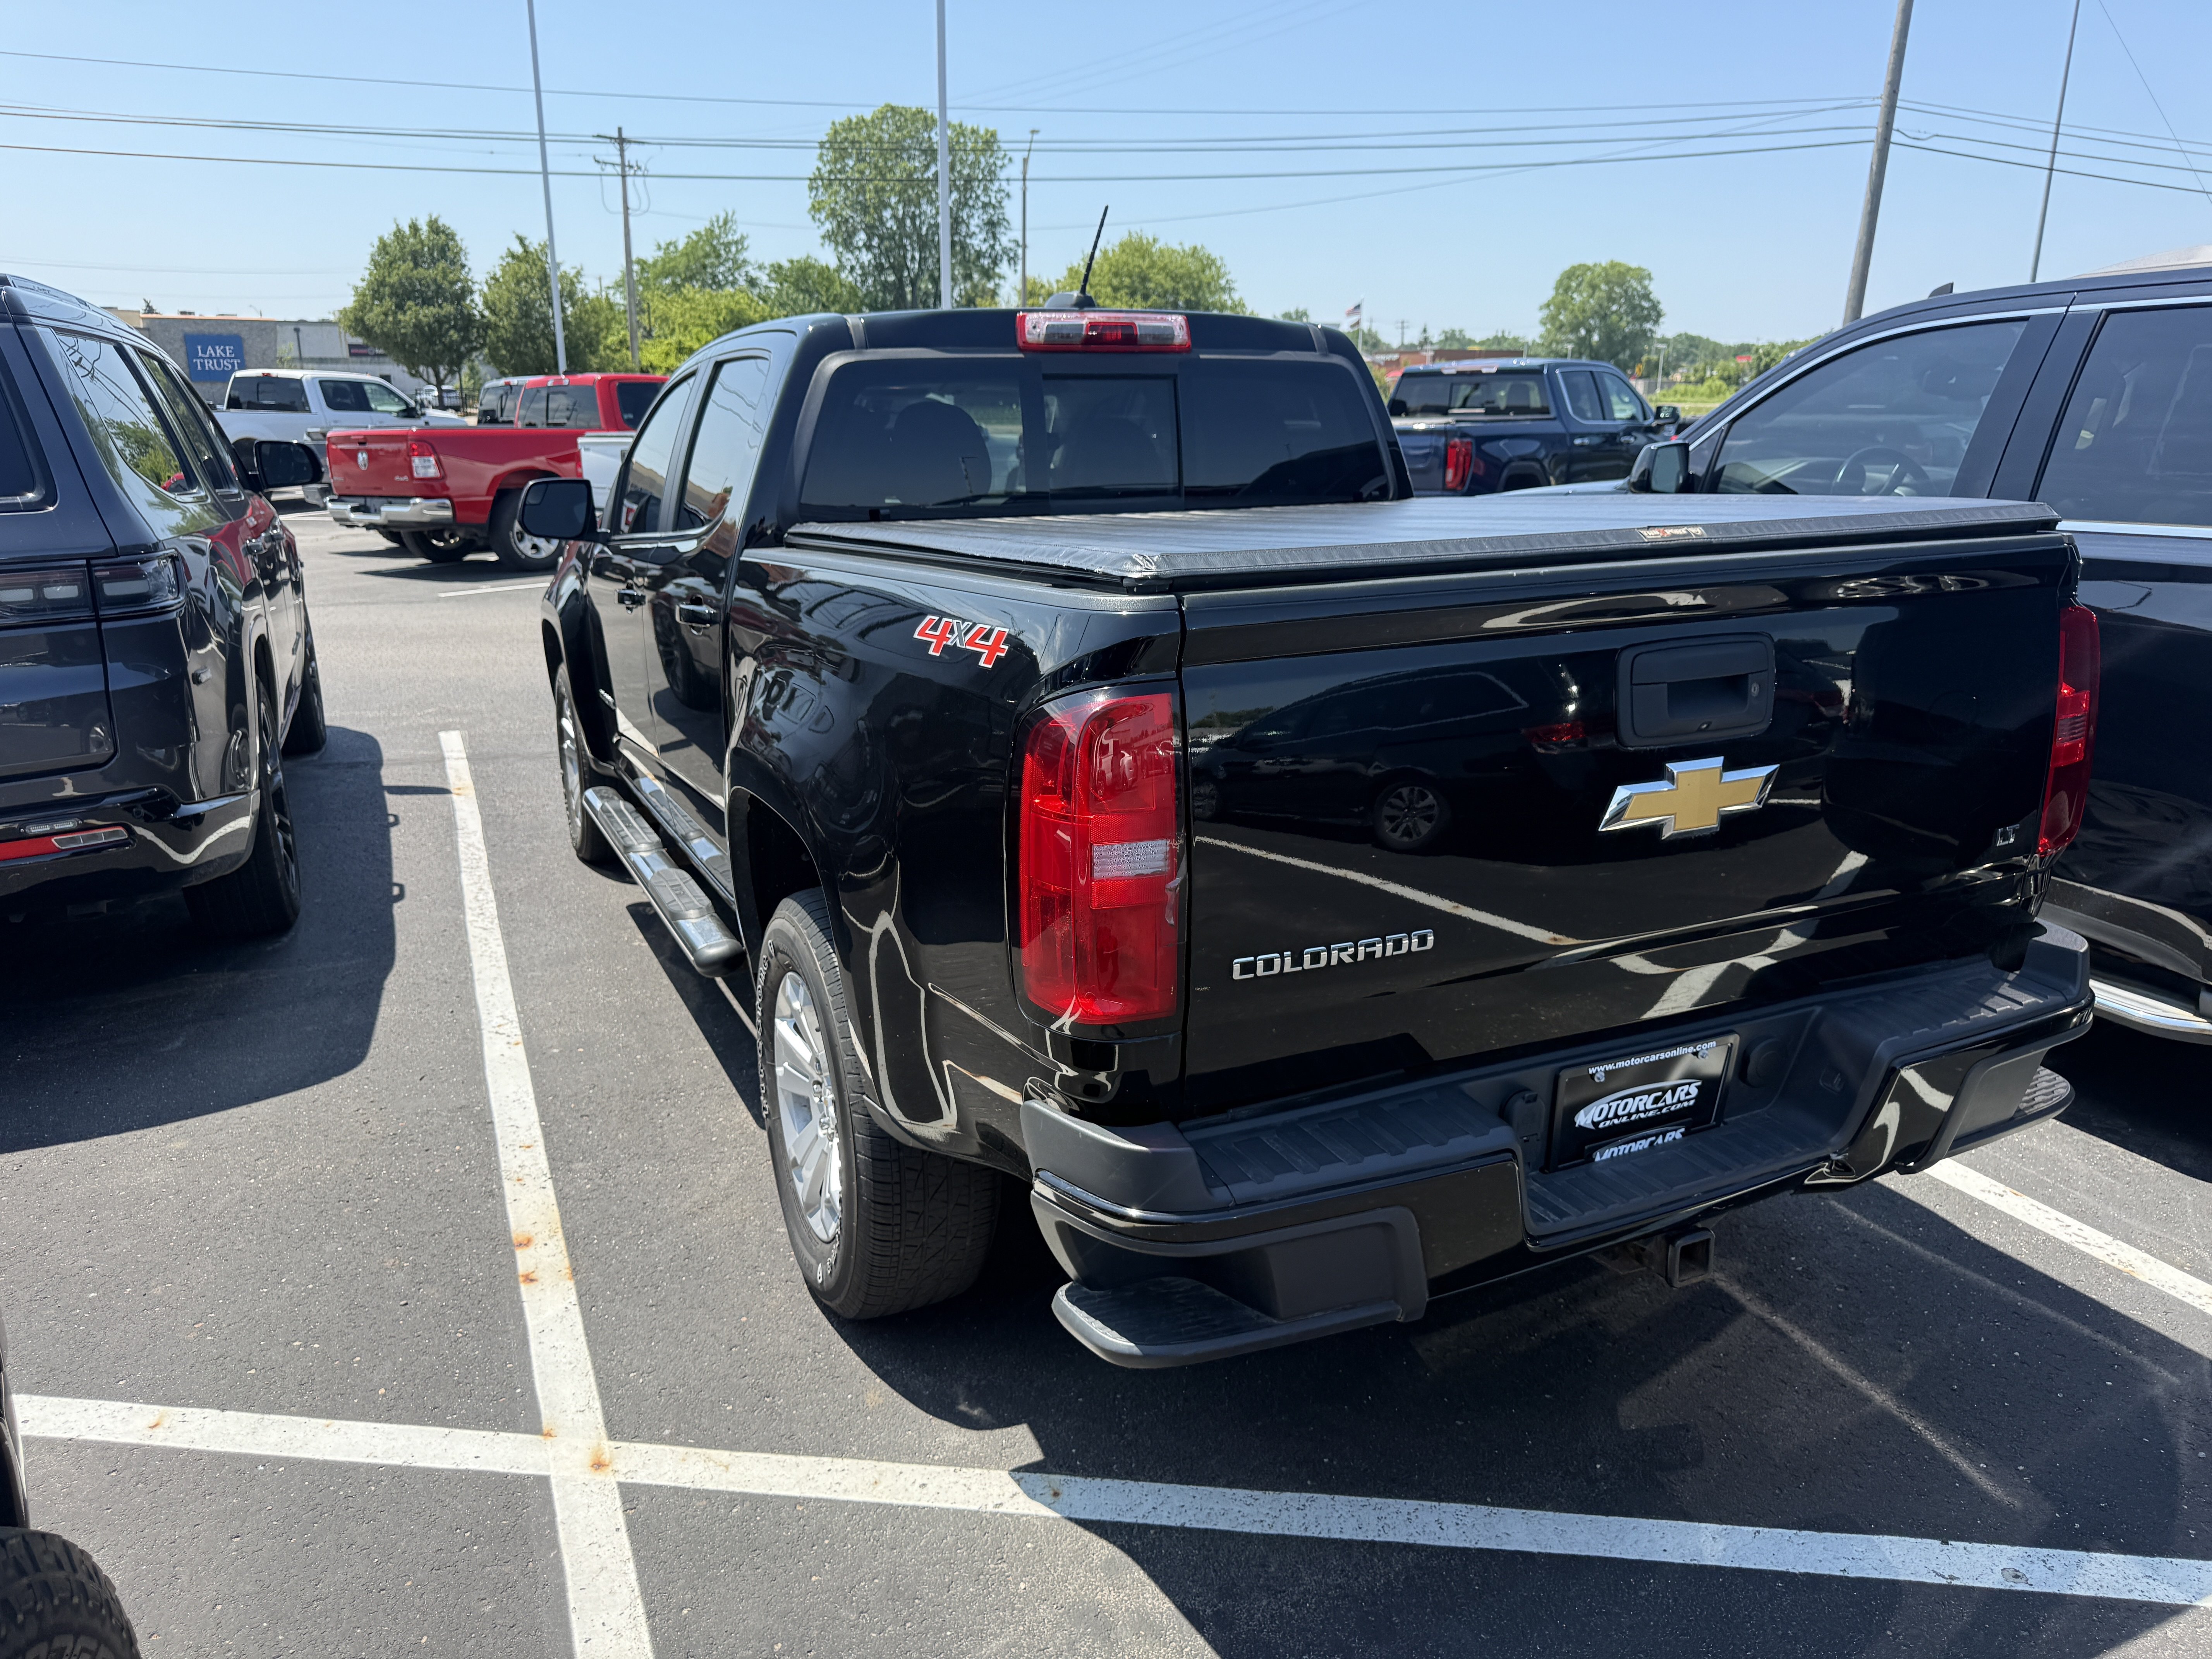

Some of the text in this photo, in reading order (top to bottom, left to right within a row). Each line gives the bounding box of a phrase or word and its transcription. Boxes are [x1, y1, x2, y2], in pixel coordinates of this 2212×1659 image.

[193, 358, 240, 371] TRUST
[197, 345, 235, 357] LAKE
[1996, 824, 2020, 847] LT
[1232, 929, 1434, 980] COLORADO
[1588, 1041, 1716, 1075] www.motorcarsonline.com
[1575, 1081, 1702, 1127] MOTORCARS
[1598, 1099, 1696, 1128] ONLINE.COM
